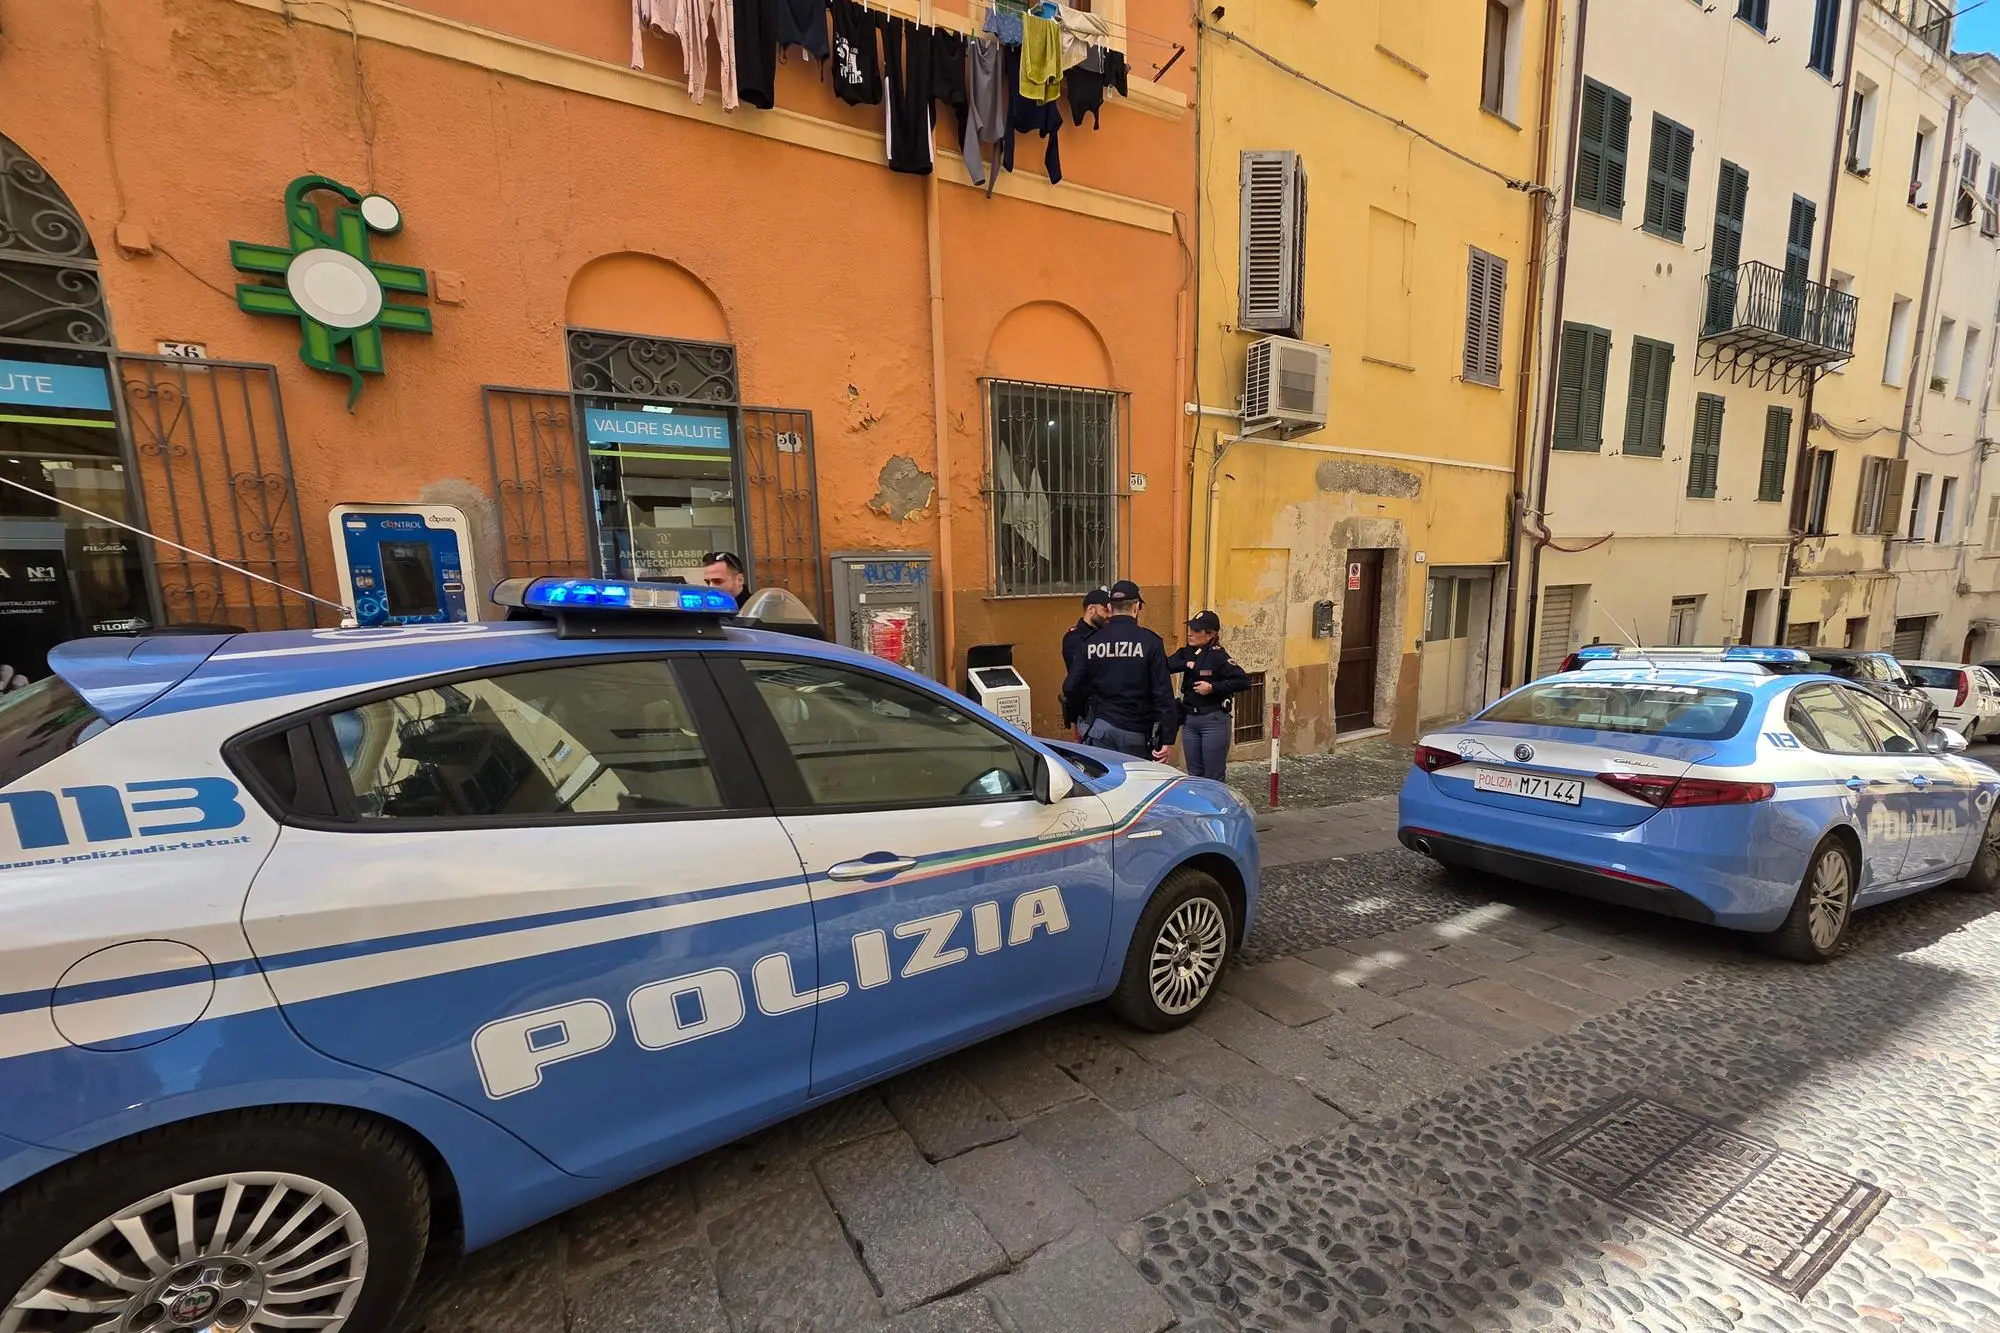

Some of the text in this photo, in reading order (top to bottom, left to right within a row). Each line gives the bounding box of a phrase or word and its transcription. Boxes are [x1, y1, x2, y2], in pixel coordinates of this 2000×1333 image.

[593, 418, 722, 440] VALORE SALUTE
[619, 549, 709, 559] ANCHE LE LABBRA
[1087, 641, 1145, 660] POLIZIA
[1762, 732, 1801, 749] 113
[1478, 773, 1575, 801] POLIZIA M7144
[0, 776, 247, 850] 113
[1865, 807, 1959, 844] POLIZIA
[470, 884, 1072, 1101] POLIZIA
